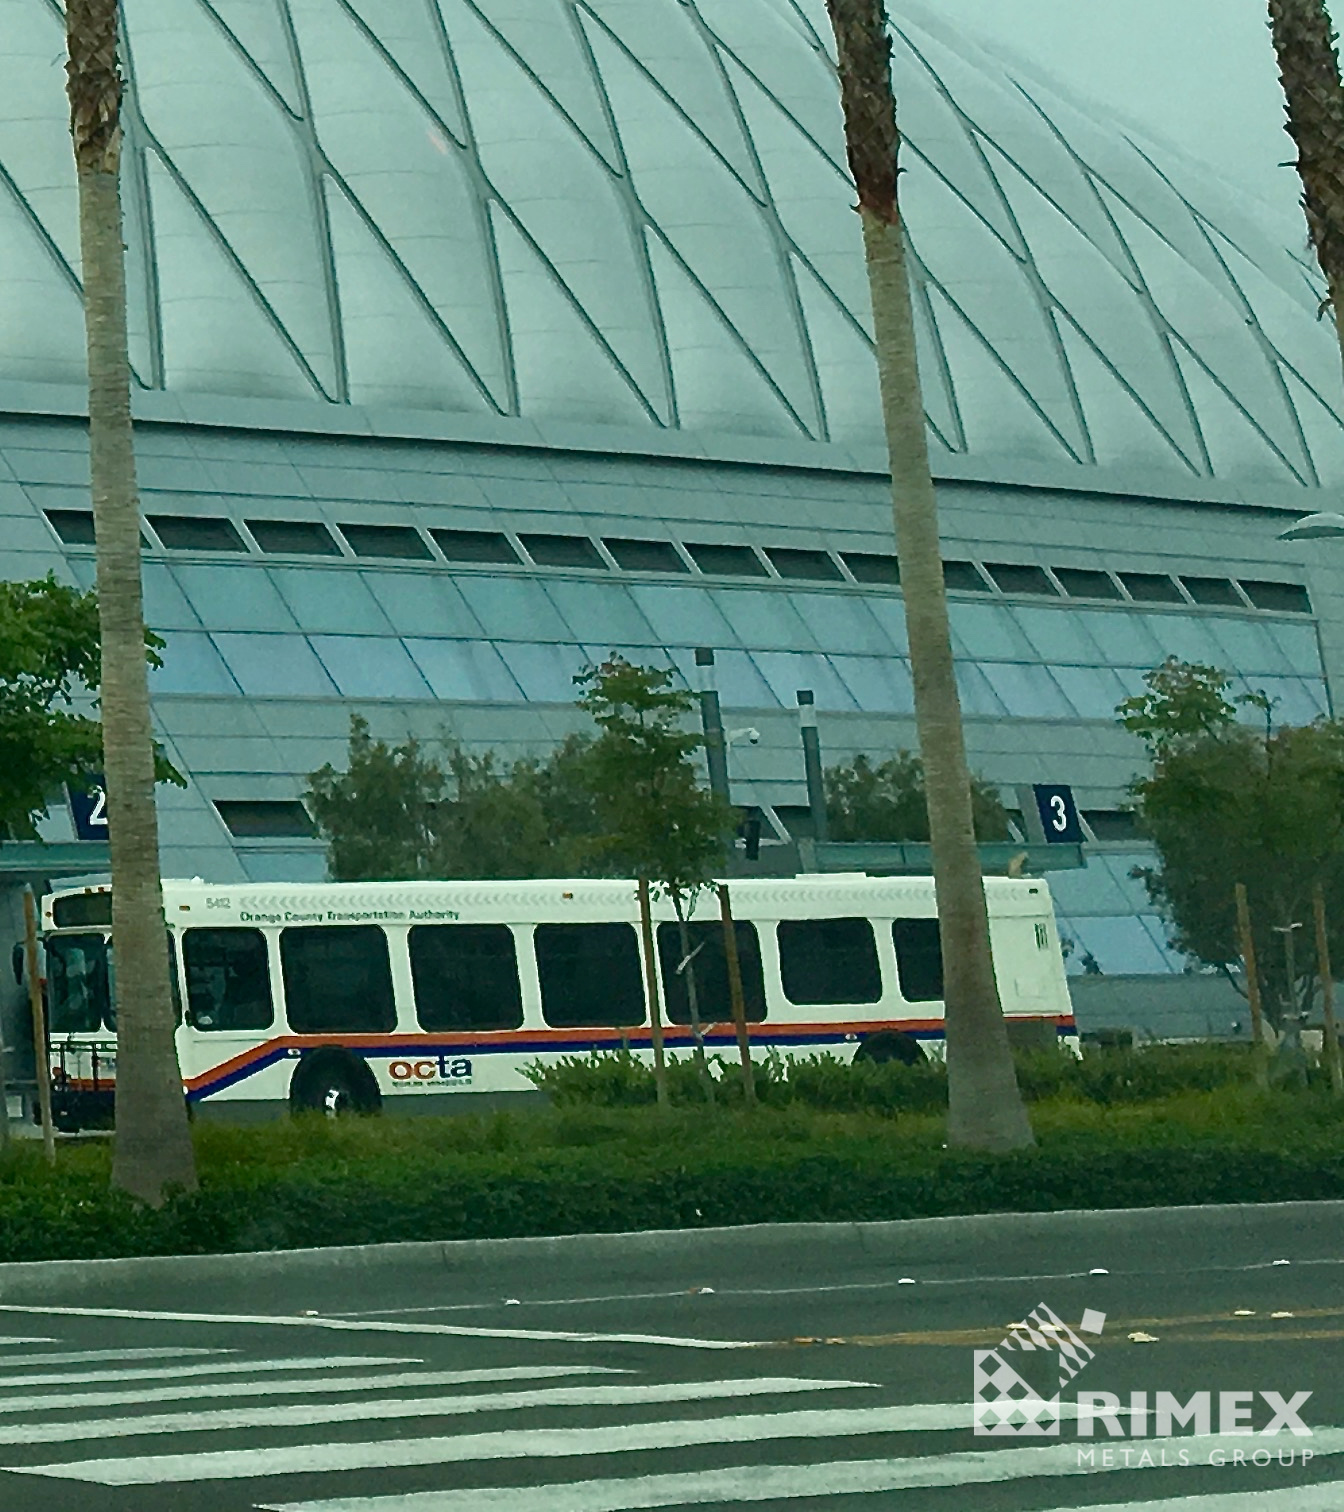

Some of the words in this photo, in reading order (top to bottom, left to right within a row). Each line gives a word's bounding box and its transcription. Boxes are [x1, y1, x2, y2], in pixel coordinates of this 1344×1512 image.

[87, 785, 108, 825] 2
[1051, 795, 1067, 832] 3
[240, 911, 282, 923] Orange
[284, 911, 323, 923] County
[327, 910, 405, 922] Transportation
[409, 909, 460, 921] Authority
[389, 1055, 472, 1079] octa
